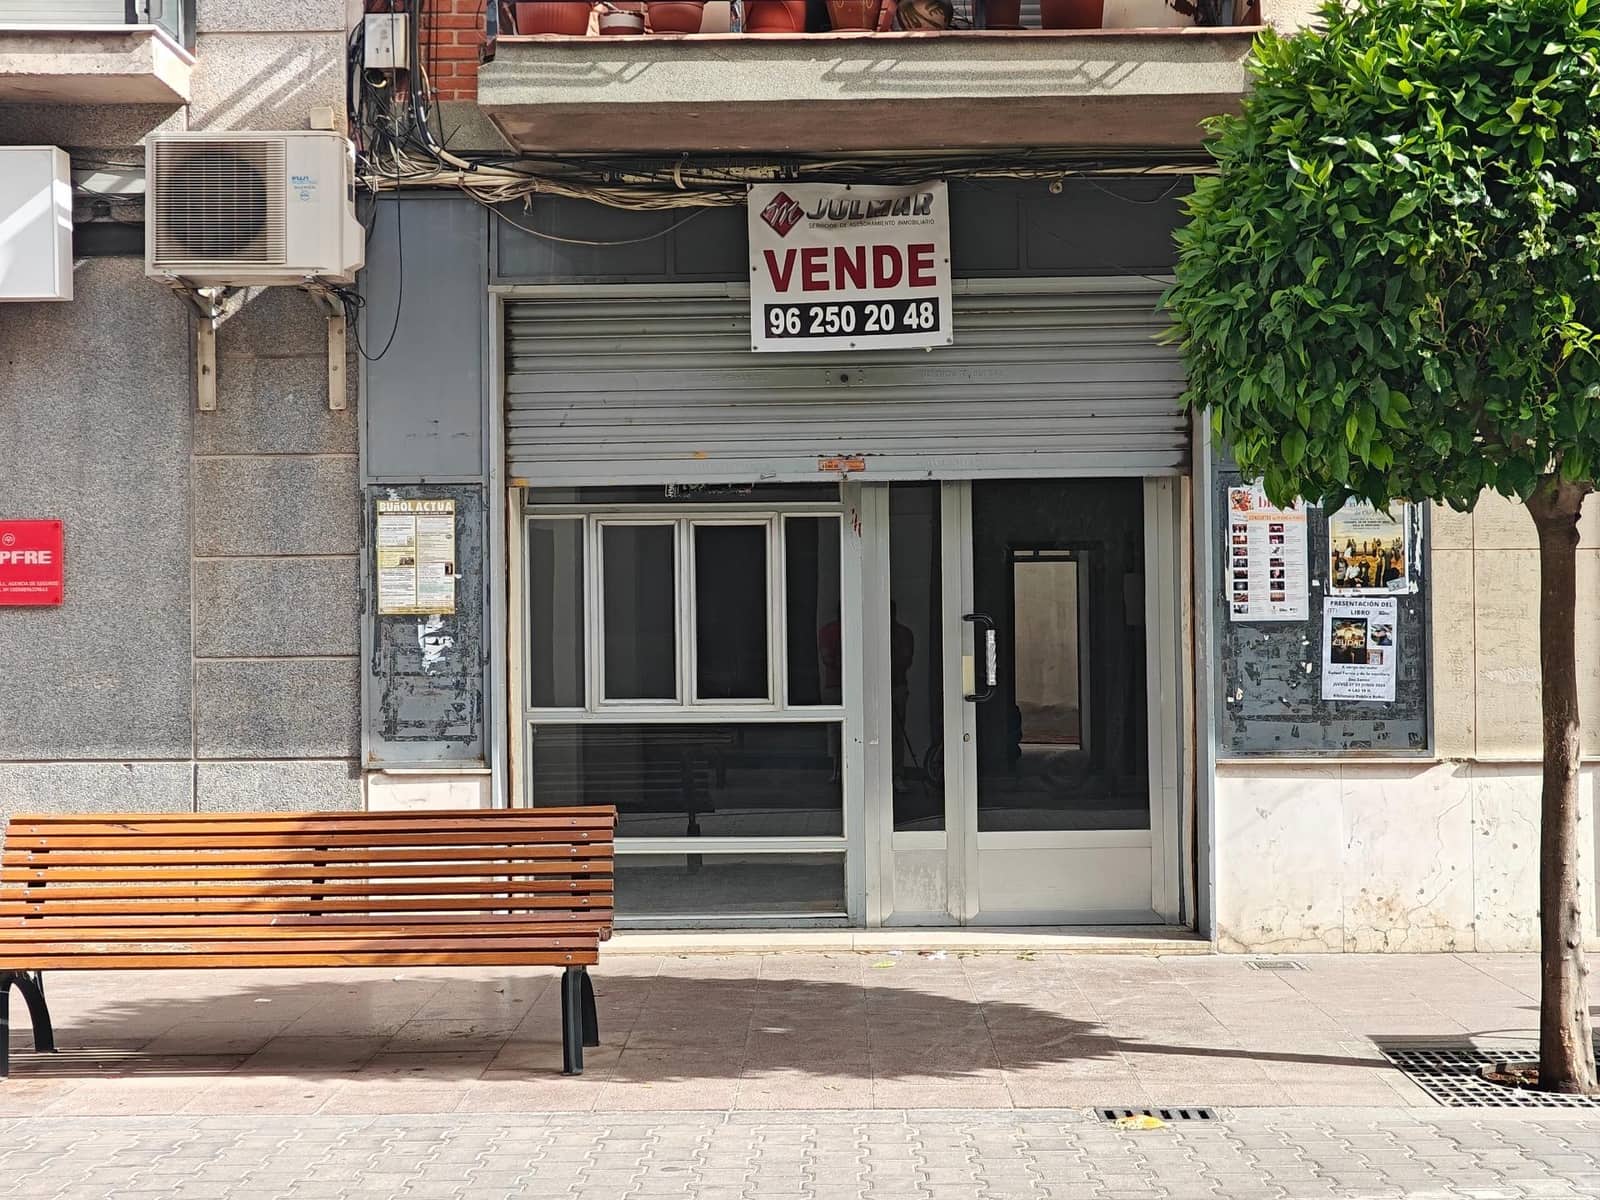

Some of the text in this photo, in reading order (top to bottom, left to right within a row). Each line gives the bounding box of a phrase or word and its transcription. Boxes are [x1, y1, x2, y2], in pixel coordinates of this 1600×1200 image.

[806, 193, 934, 221] JULMAR
[763, 243, 937, 293] VENDE
[769, 301, 934, 335] 96 250 20 48
[415, 502, 453, 511] ACTUA
[1330, 600, 1380, 608] PRESENTACIÓN
